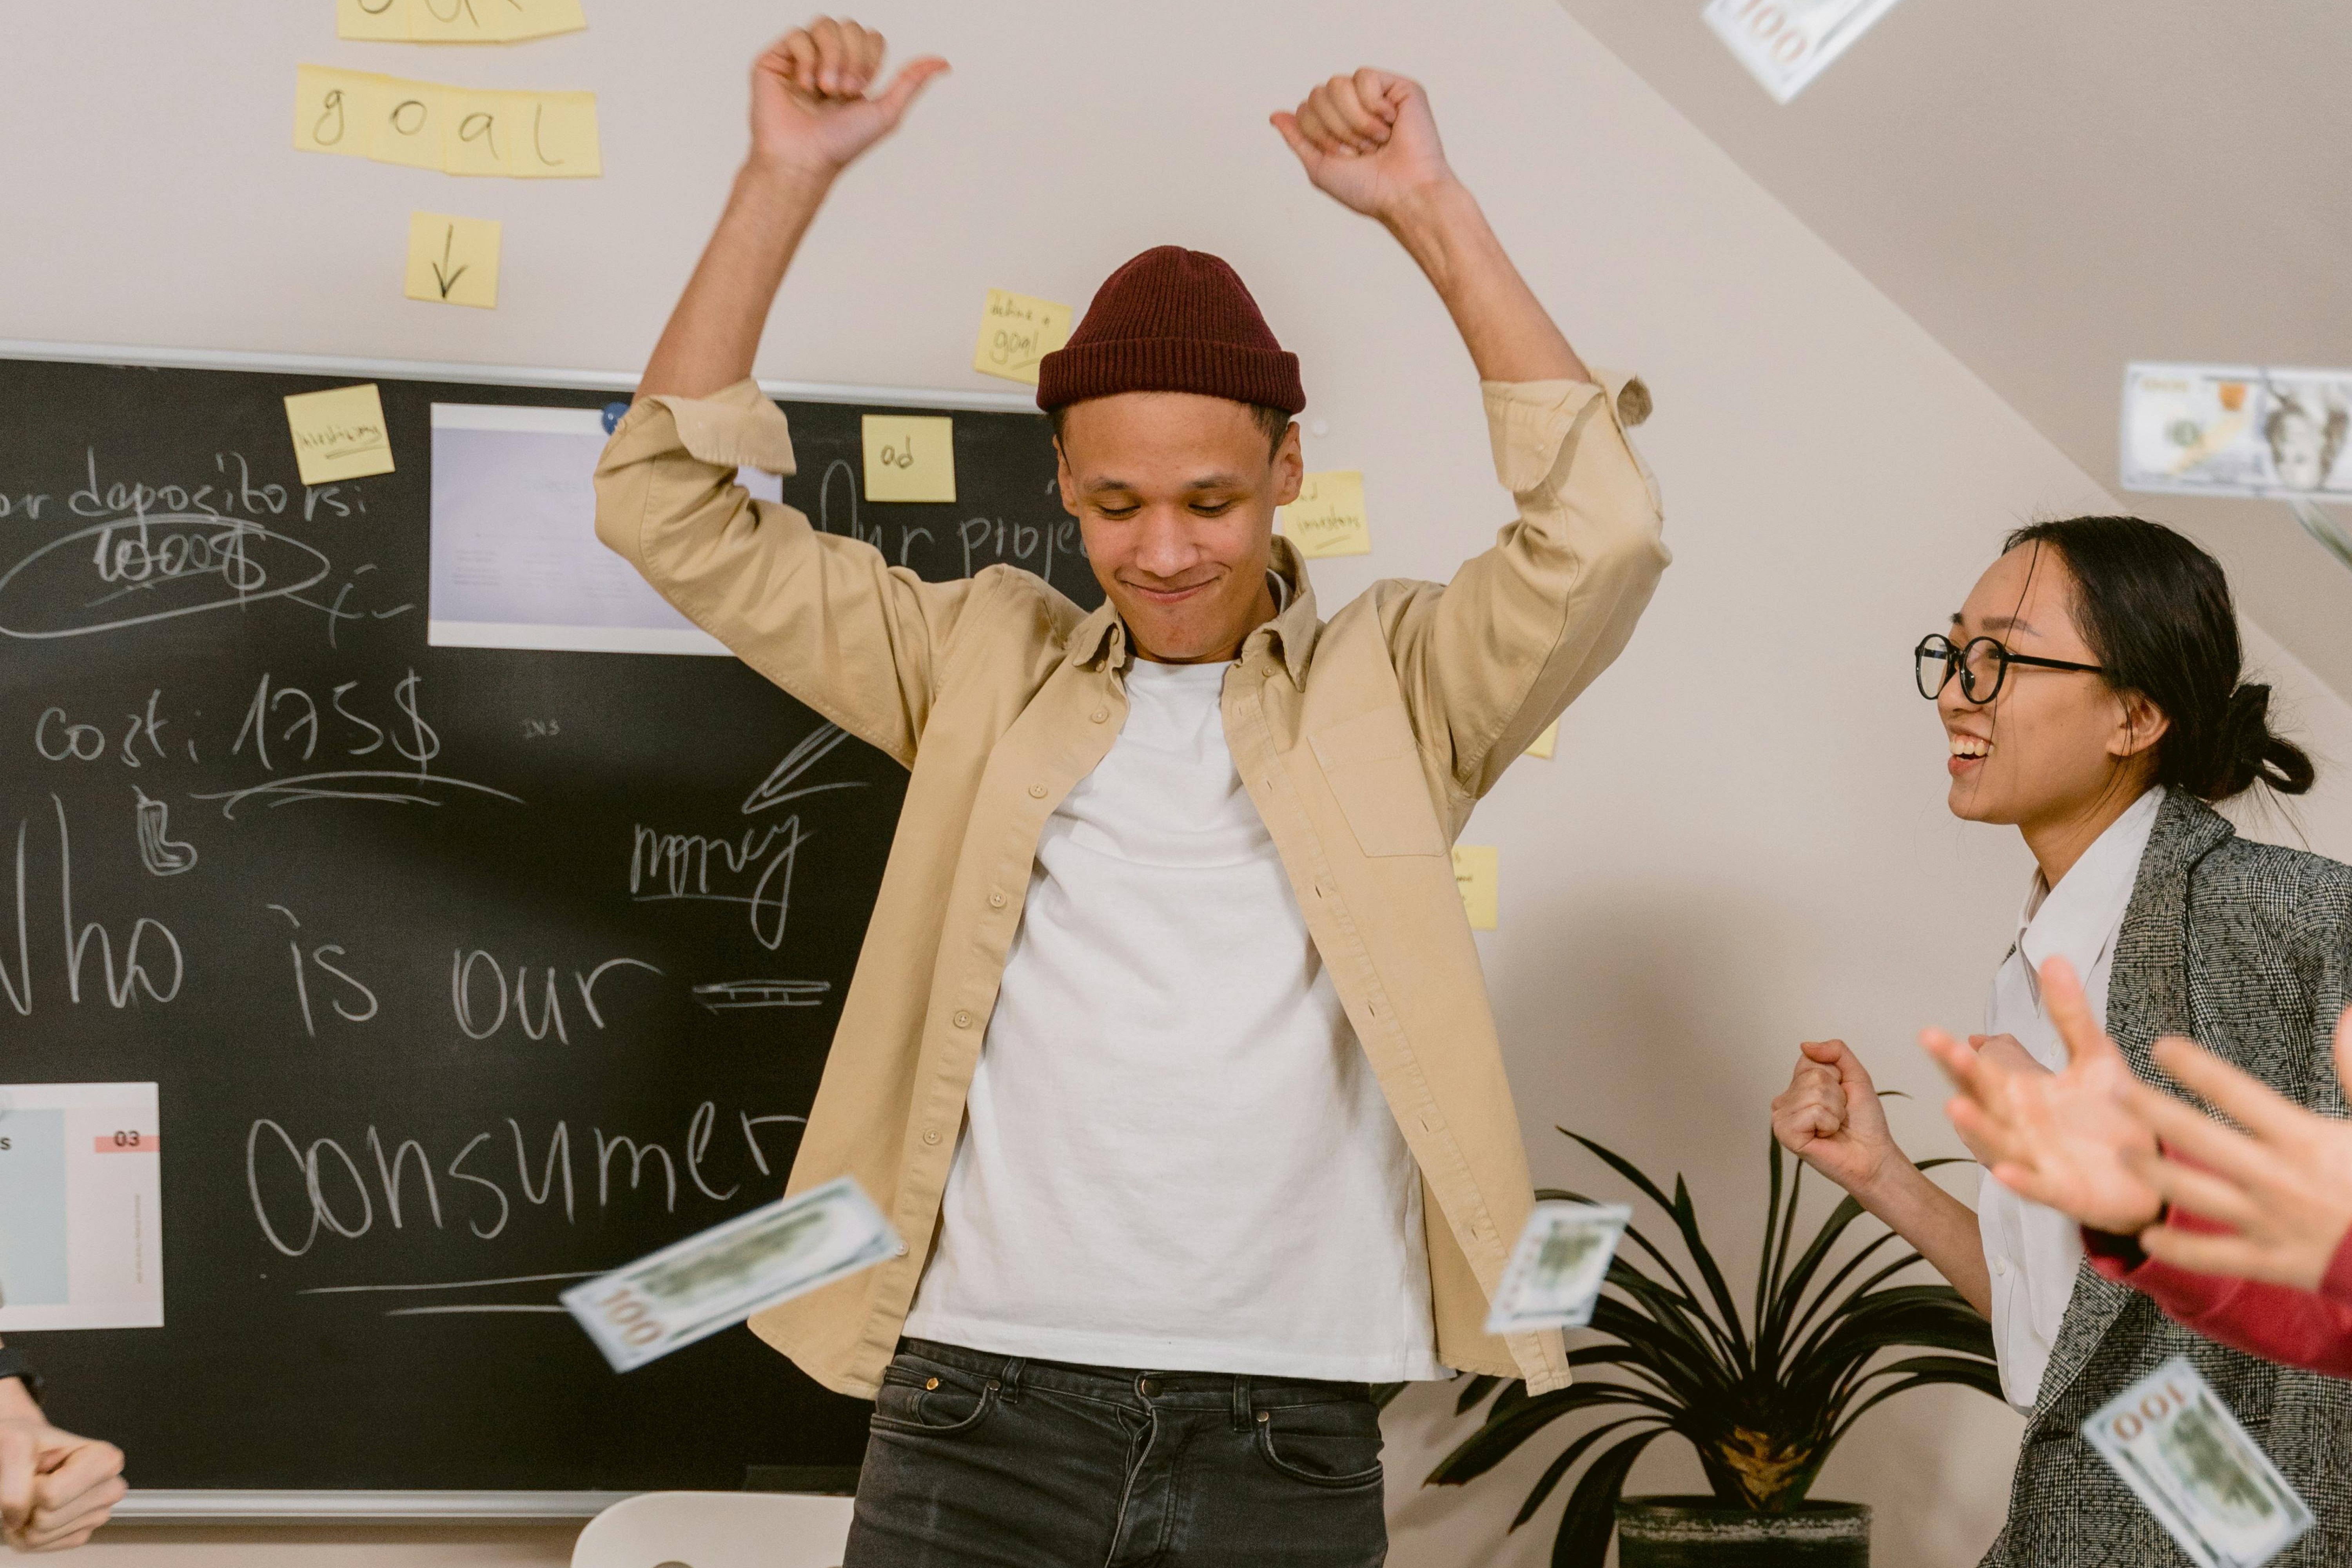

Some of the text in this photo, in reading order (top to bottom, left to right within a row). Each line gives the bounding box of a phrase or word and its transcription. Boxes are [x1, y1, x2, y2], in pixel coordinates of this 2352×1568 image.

[314, 89, 565, 166] goal
[989, 329, 1039, 365] goal
[880, 434, 914, 469] ad
[231, 667, 441, 786] 175$
[630, 815, 815, 950] money
[266, 903, 379, 1038] is
[114, 1131, 140, 1146] 03
[598, 1288, 665, 1347] 100
[2112, 1381, 2187, 1441] 100
